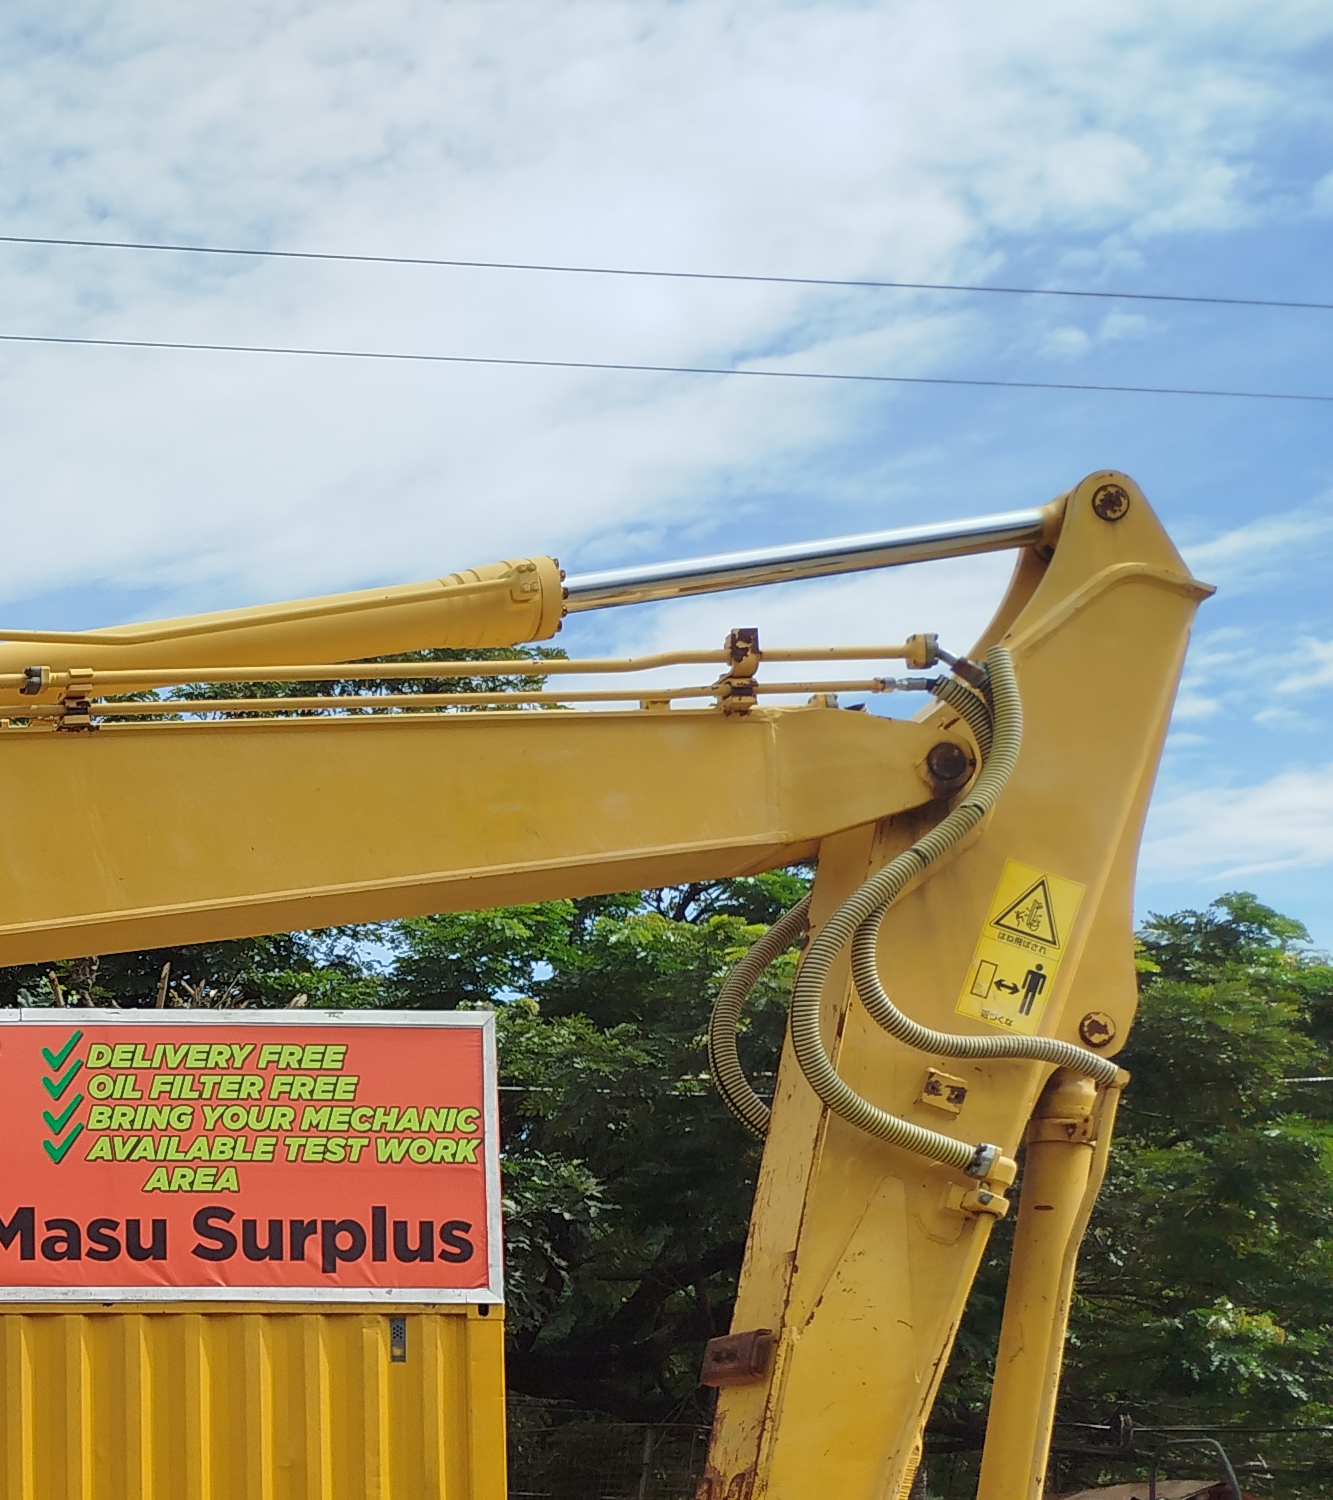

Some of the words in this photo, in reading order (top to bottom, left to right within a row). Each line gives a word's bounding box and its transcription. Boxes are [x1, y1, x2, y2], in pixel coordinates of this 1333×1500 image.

[997, 931, 1047, 955] はね飛ばされ
[86, 1043, 253, 1070] DELIVERY
[259, 1044, 347, 1071] FREE
[87, 1074, 147, 1100] OIL
[150, 1074, 266, 1101] FILTER
[271, 1075, 359, 1102] FREE
[87, 1105, 195, 1131] BRING
[203, 1106, 295, 1132] YOUR
[300, 1107, 481, 1133] MECHANIC
[86, 1136, 273, 1163] AVAILABLE
[284, 1137, 369, 1163] TEST
[375, 1138, 485, 1164] WORK
[141, 1168, 240, 1193] AREA
[192, 1206, 474, 1274] Surplus
